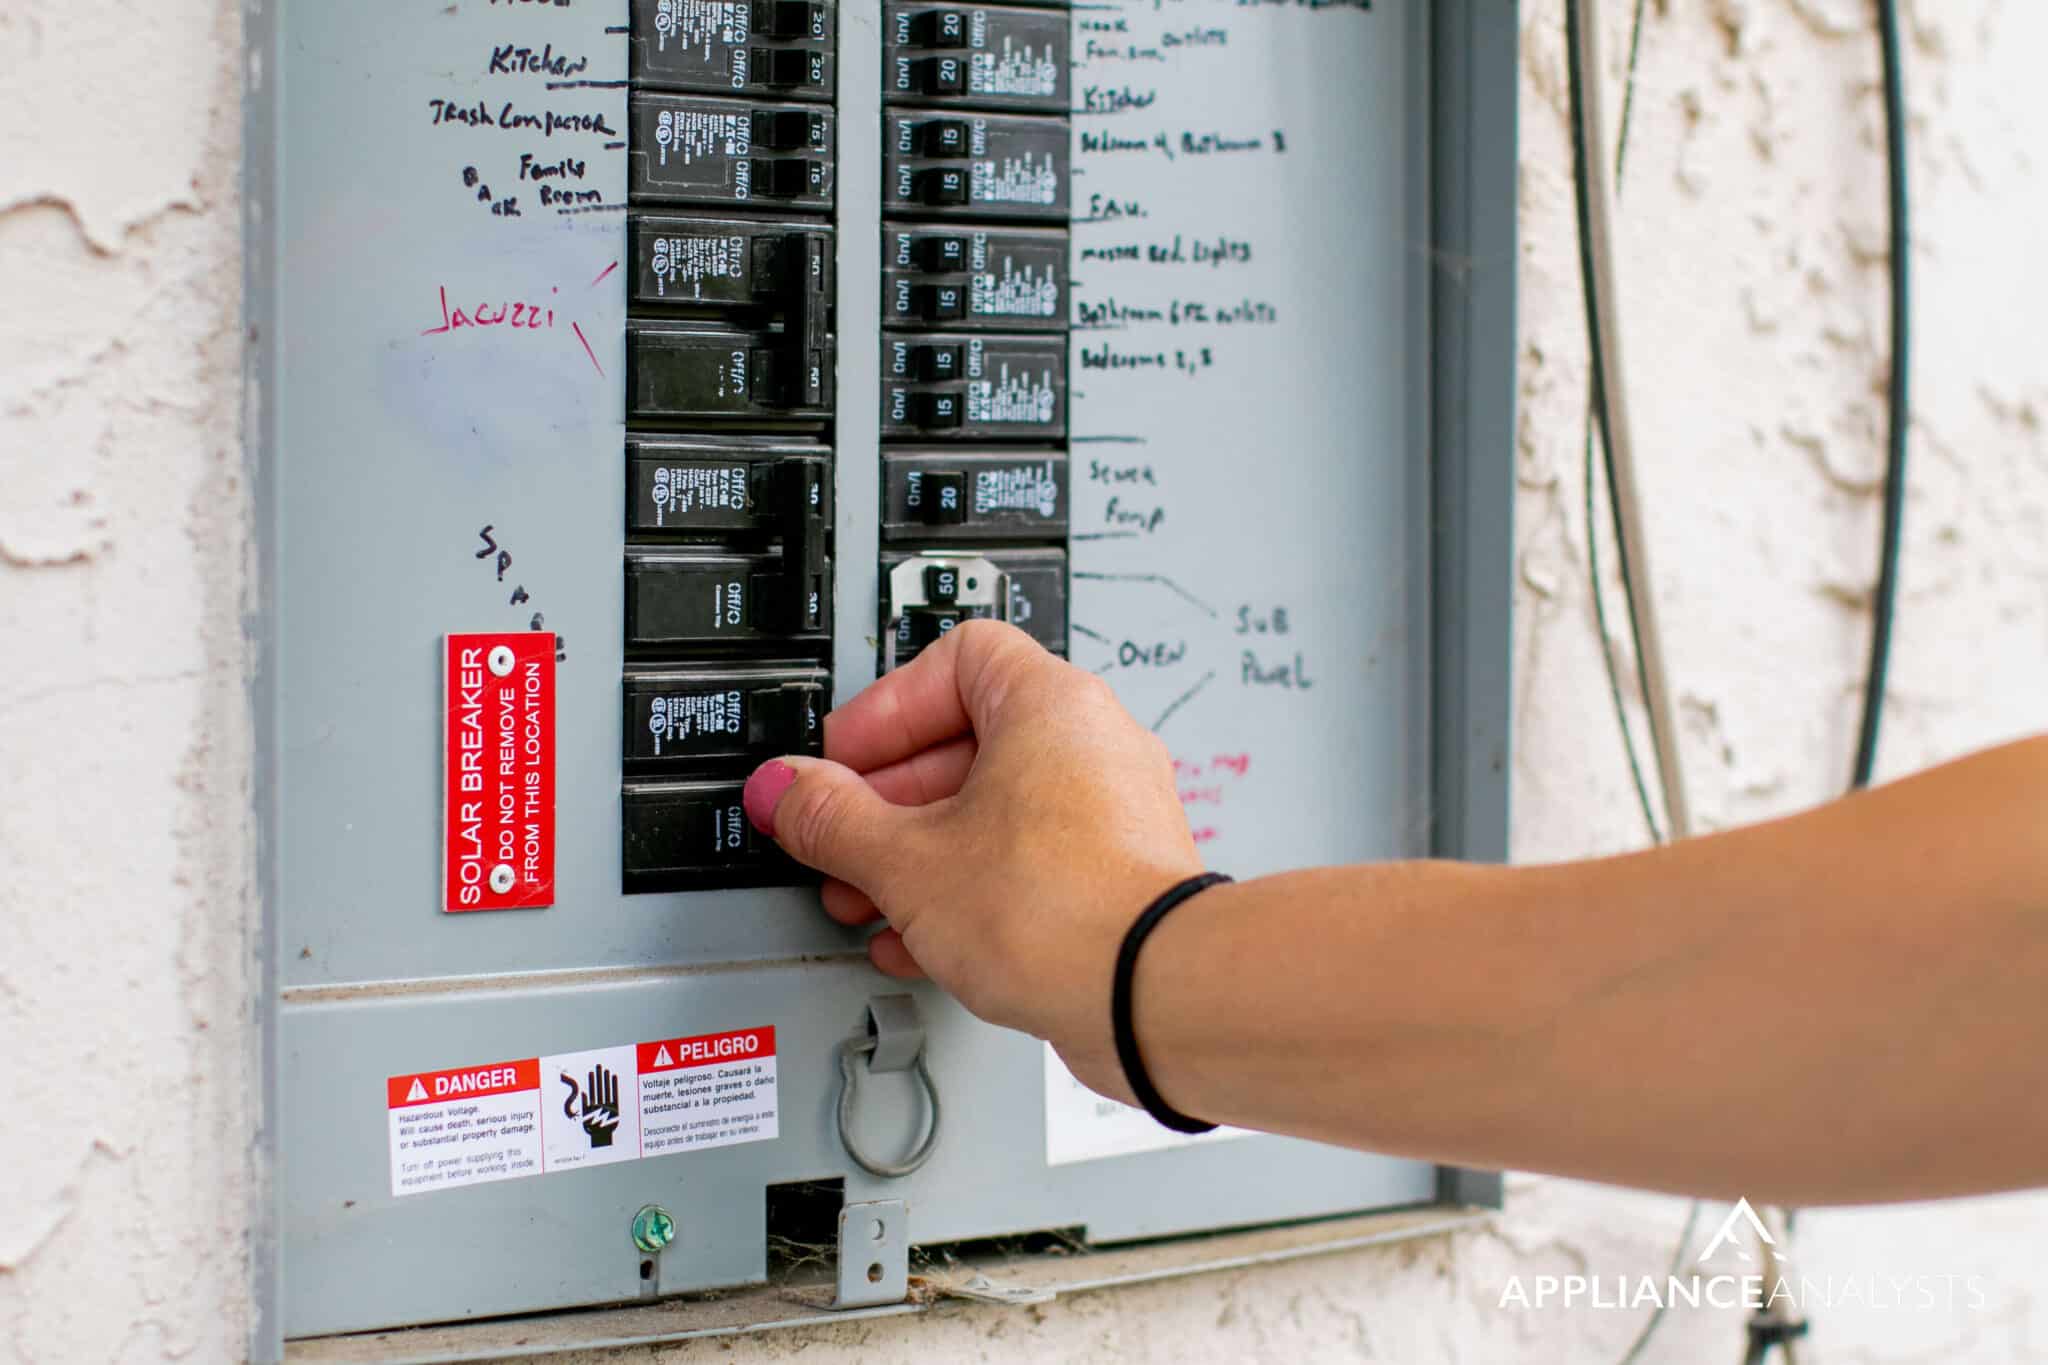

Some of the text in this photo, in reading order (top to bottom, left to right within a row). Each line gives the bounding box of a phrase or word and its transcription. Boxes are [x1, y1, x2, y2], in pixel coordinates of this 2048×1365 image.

[813, 11, 823, 33] 20
[944, 15, 959, 35] 20
[812, 58, 821, 80] 20
[942, 60, 956, 80] 20
[812, 123, 820, 139] 15
[943, 128, 958, 144] 15
[811, 168, 820, 184] 15
[944, 174, 958, 189] 15
[944, 241, 959, 257] 15
[941, 290, 956, 307] 15
[937, 352, 951, 368] 15
[938, 399, 952, 416] 15
[942, 486, 956, 509] 20
[939, 573, 953, 594] 50
[727, 691, 740, 733] Off/O
[460, 647, 483, 904] SOLAR BREAKER
[500, 687, 514, 860] DO NOT REMOVE
[524, 662, 540, 882] FROM THIS LOCATION
[680, 1035, 758, 1061] PELIGRO
[435, 1068, 517, 1095] DANGER
[642, 1078, 670, 1089] Voltaje
[674, 1073, 714, 1086] peligroso.
[754, 1065, 762, 1073] la
[678, 1086, 712, 1097] lesiones
[716, 1081, 742, 1093] graves
[399, 1106, 480, 1123] Hazardous Voltage.
[643, 1101, 691, 1114] substancial
[703, 1098, 710, 1106] la
[400, 1127, 414, 1136] Will
[419, 1124, 443, 1134] cause
[476, 1115, 507, 1125] serious
[511, 1111, 534, 1122] injury
[400, 1124, 535, 1149] or substantial property damage.
